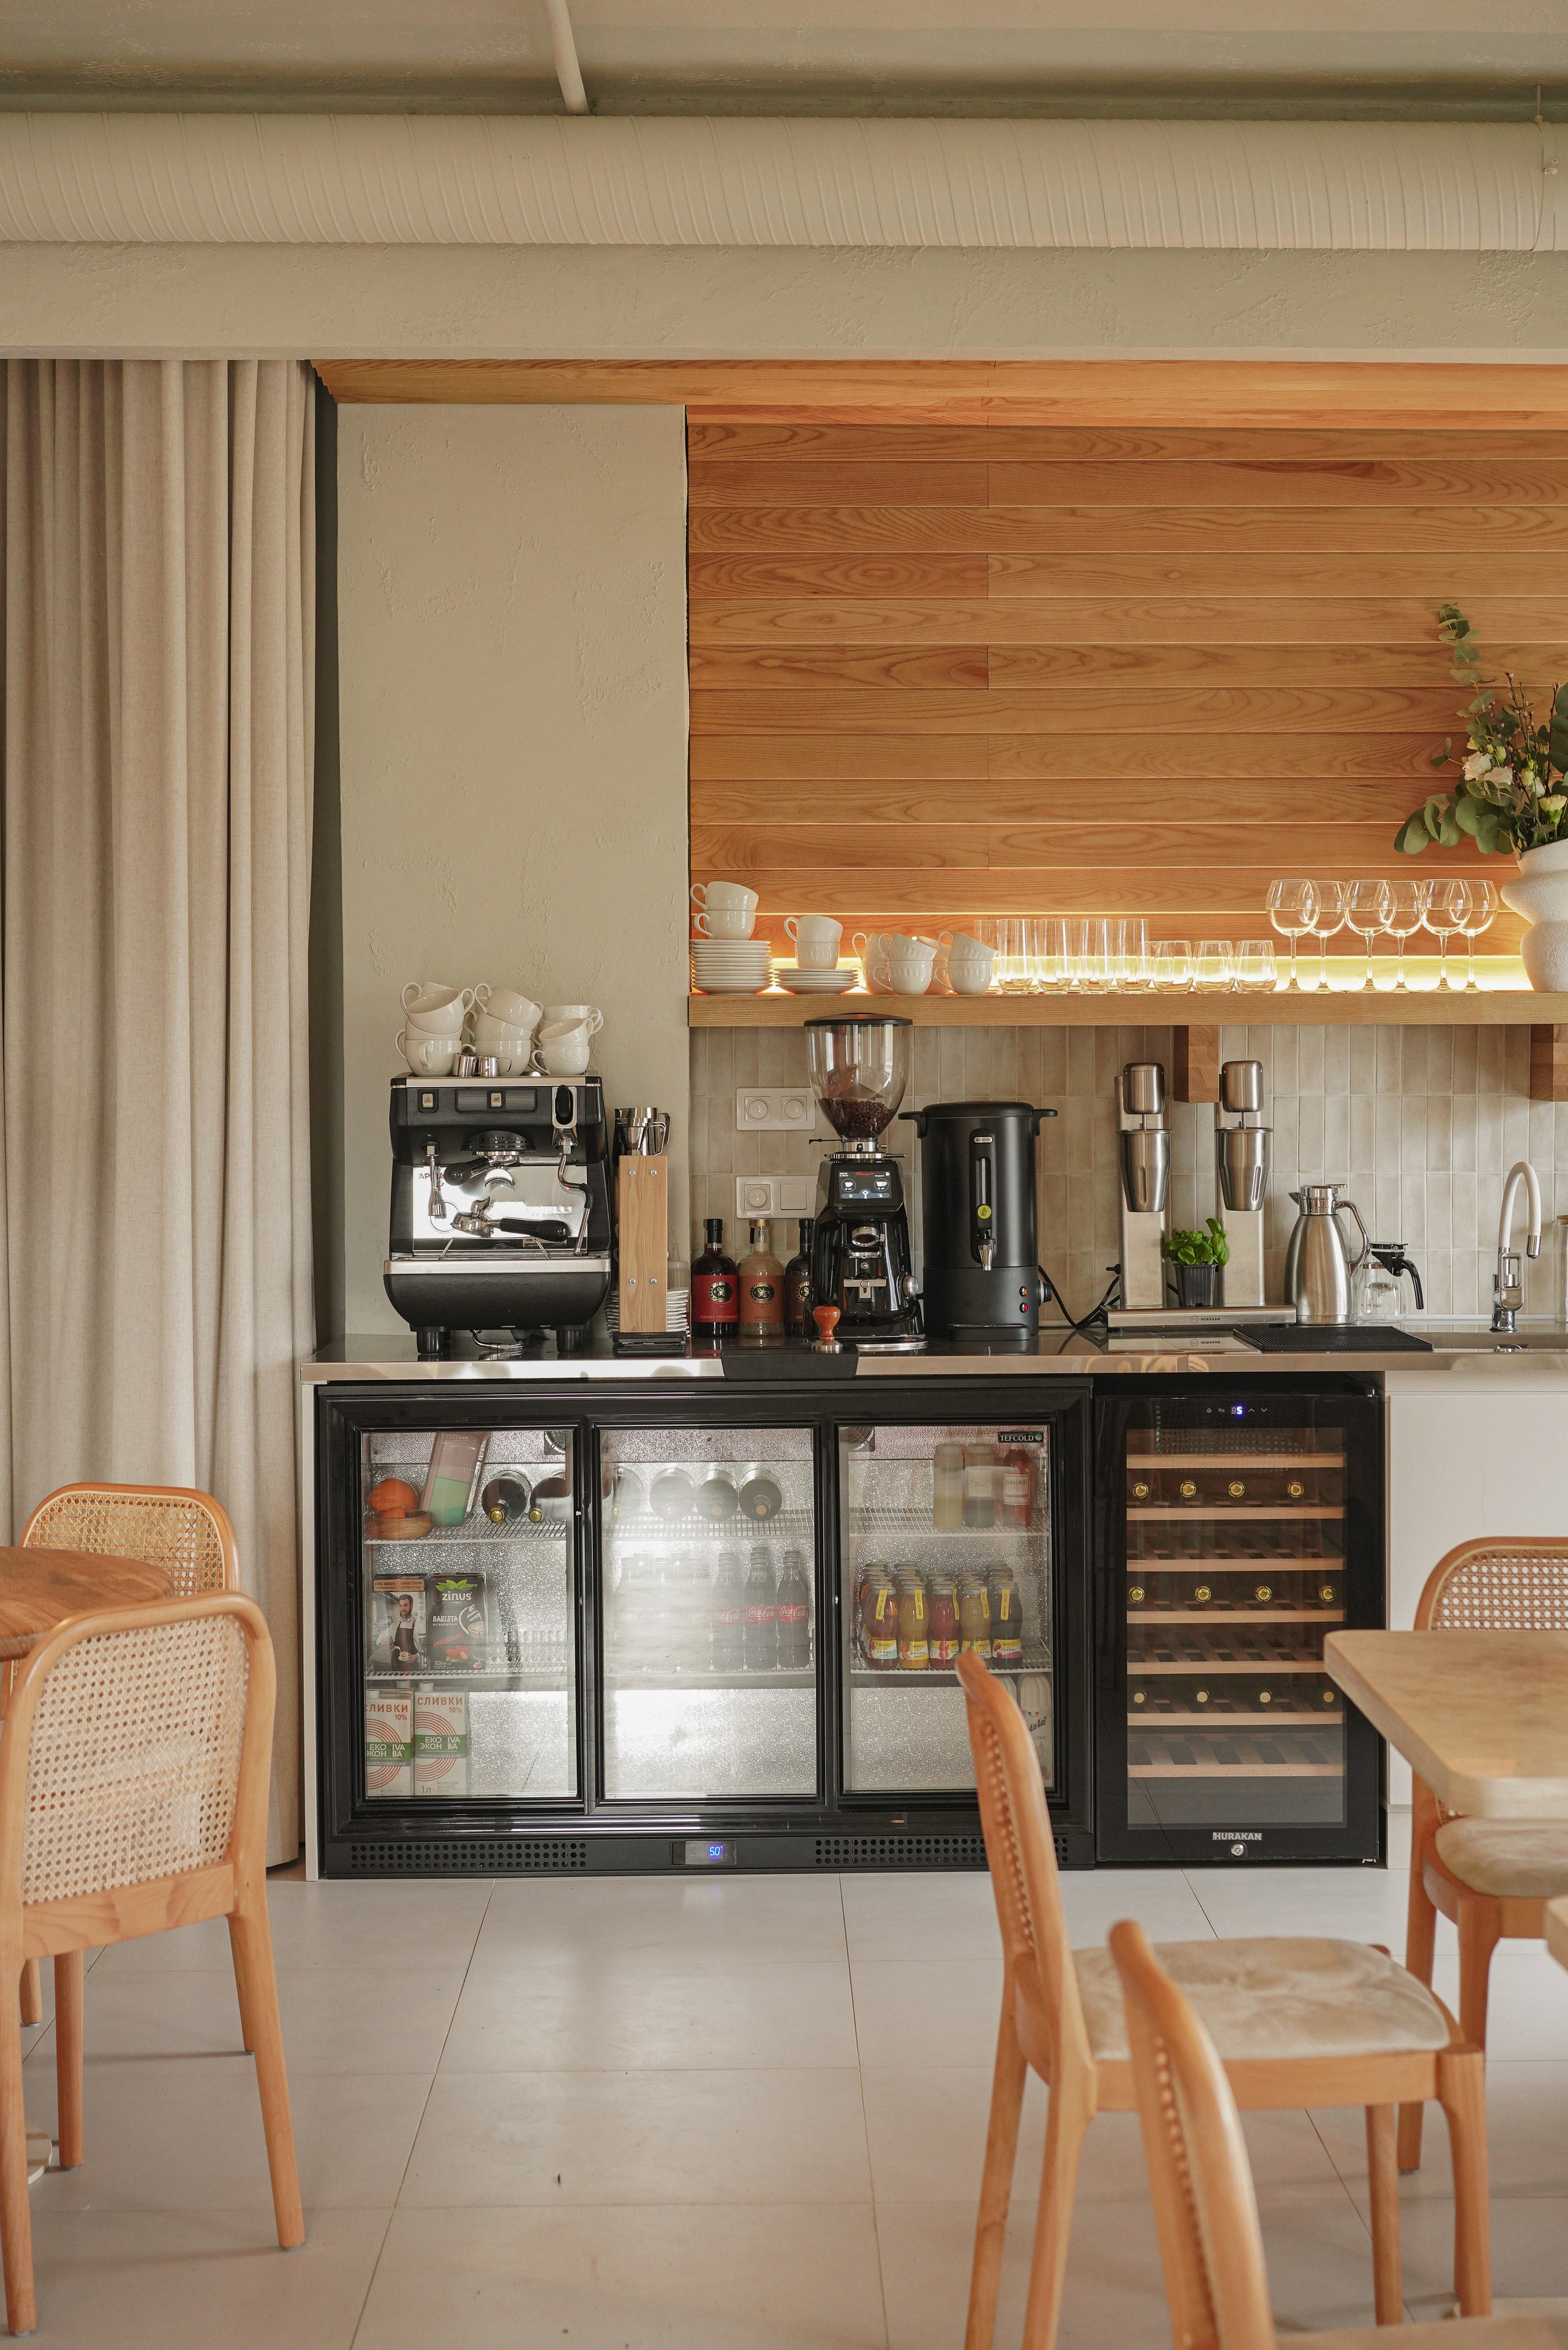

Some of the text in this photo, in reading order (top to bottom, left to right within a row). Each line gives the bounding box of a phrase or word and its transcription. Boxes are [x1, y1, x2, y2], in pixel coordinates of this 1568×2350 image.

[442, 1591, 472, 1601] zinus
[748, 1606, 775, 1618] Coca-Cola
[780, 1605, 807, 1618] Coca-Cola
